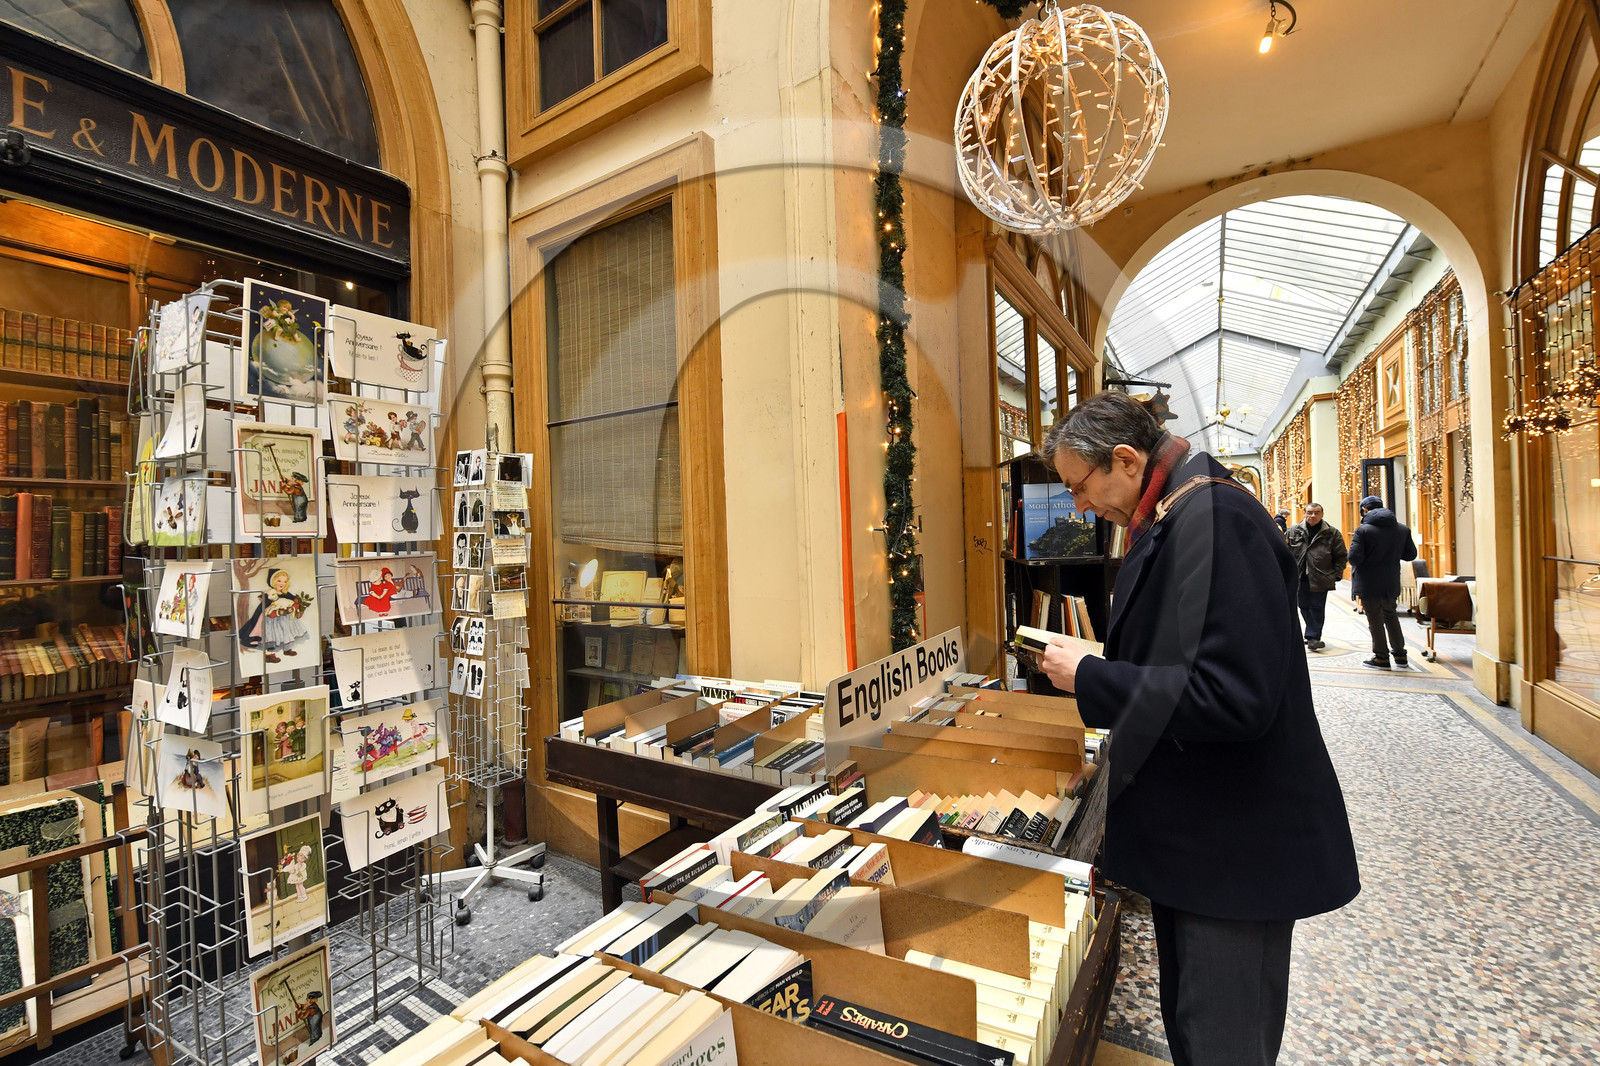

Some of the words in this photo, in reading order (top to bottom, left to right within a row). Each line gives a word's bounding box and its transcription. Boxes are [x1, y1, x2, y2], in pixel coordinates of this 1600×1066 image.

[71, 117, 106, 157] &
[128, 110, 395, 249] MODERNE
[837, 654, 914, 728] English
[915, 636, 960, 684] Books
[1024, 814, 1042, 840] BOYD
[691, 862, 708, 877] RICHARD
[775, 979, 787, 990] MAN
[791, 968, 804, 981] WILD
[758, 982, 801, 1017] EAR
[839, 1005, 910, 1040] CARAÏBES
